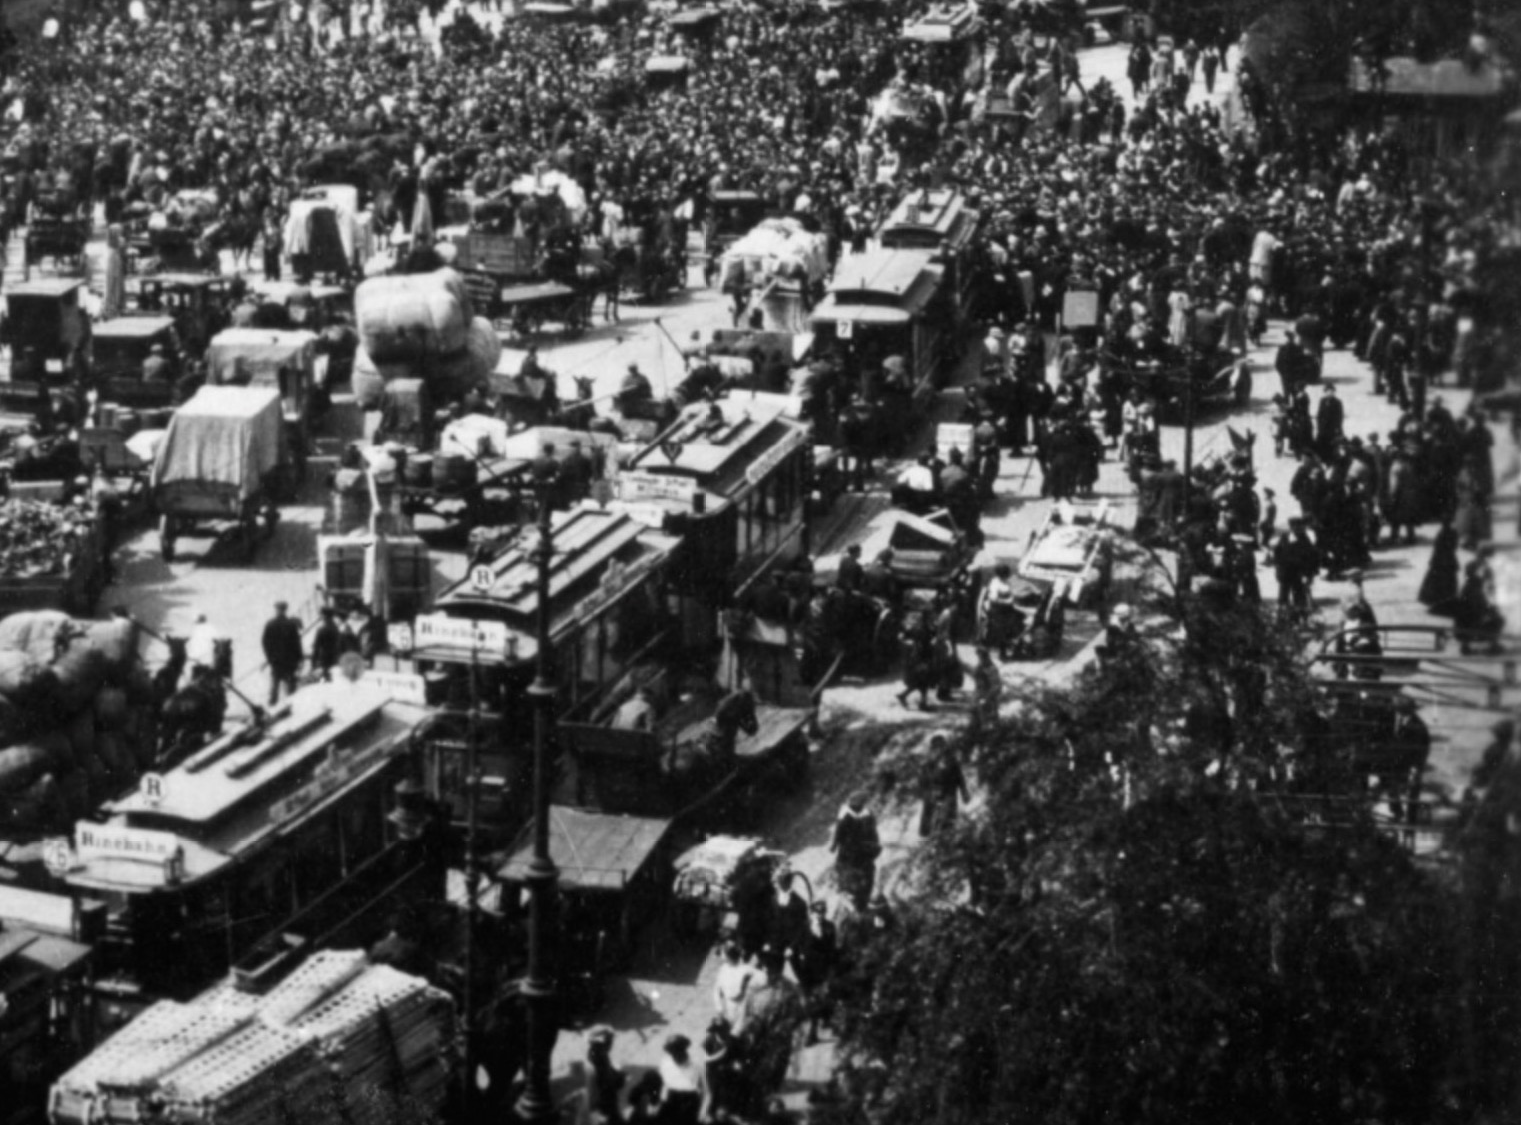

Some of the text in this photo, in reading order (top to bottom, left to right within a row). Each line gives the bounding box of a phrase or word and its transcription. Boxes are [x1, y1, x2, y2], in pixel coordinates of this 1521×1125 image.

[476, 570, 490, 584] R
[421, 622, 498, 641] Ringban
[146, 777, 161, 797] R
[81, 830, 167, 853] Ringbahn
